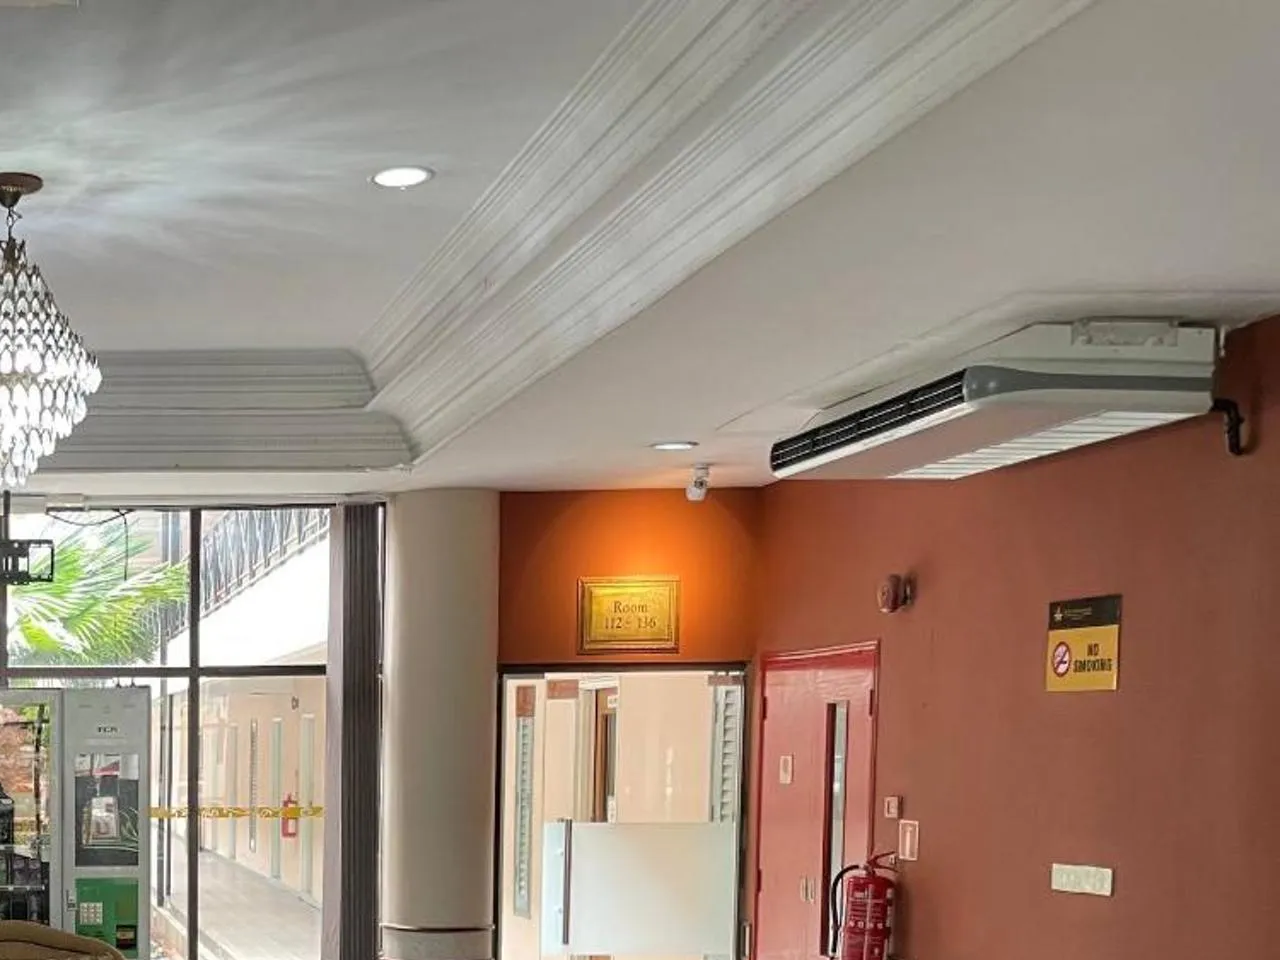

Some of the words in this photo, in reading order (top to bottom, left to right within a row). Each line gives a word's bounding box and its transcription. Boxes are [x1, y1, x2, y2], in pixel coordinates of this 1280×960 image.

[613, 600, 648, 613] Room
[605, 617, 622, 629] 112
[1087, 643, 1100, 656] NO
[1073, 658, 1113, 673] SMOKING
